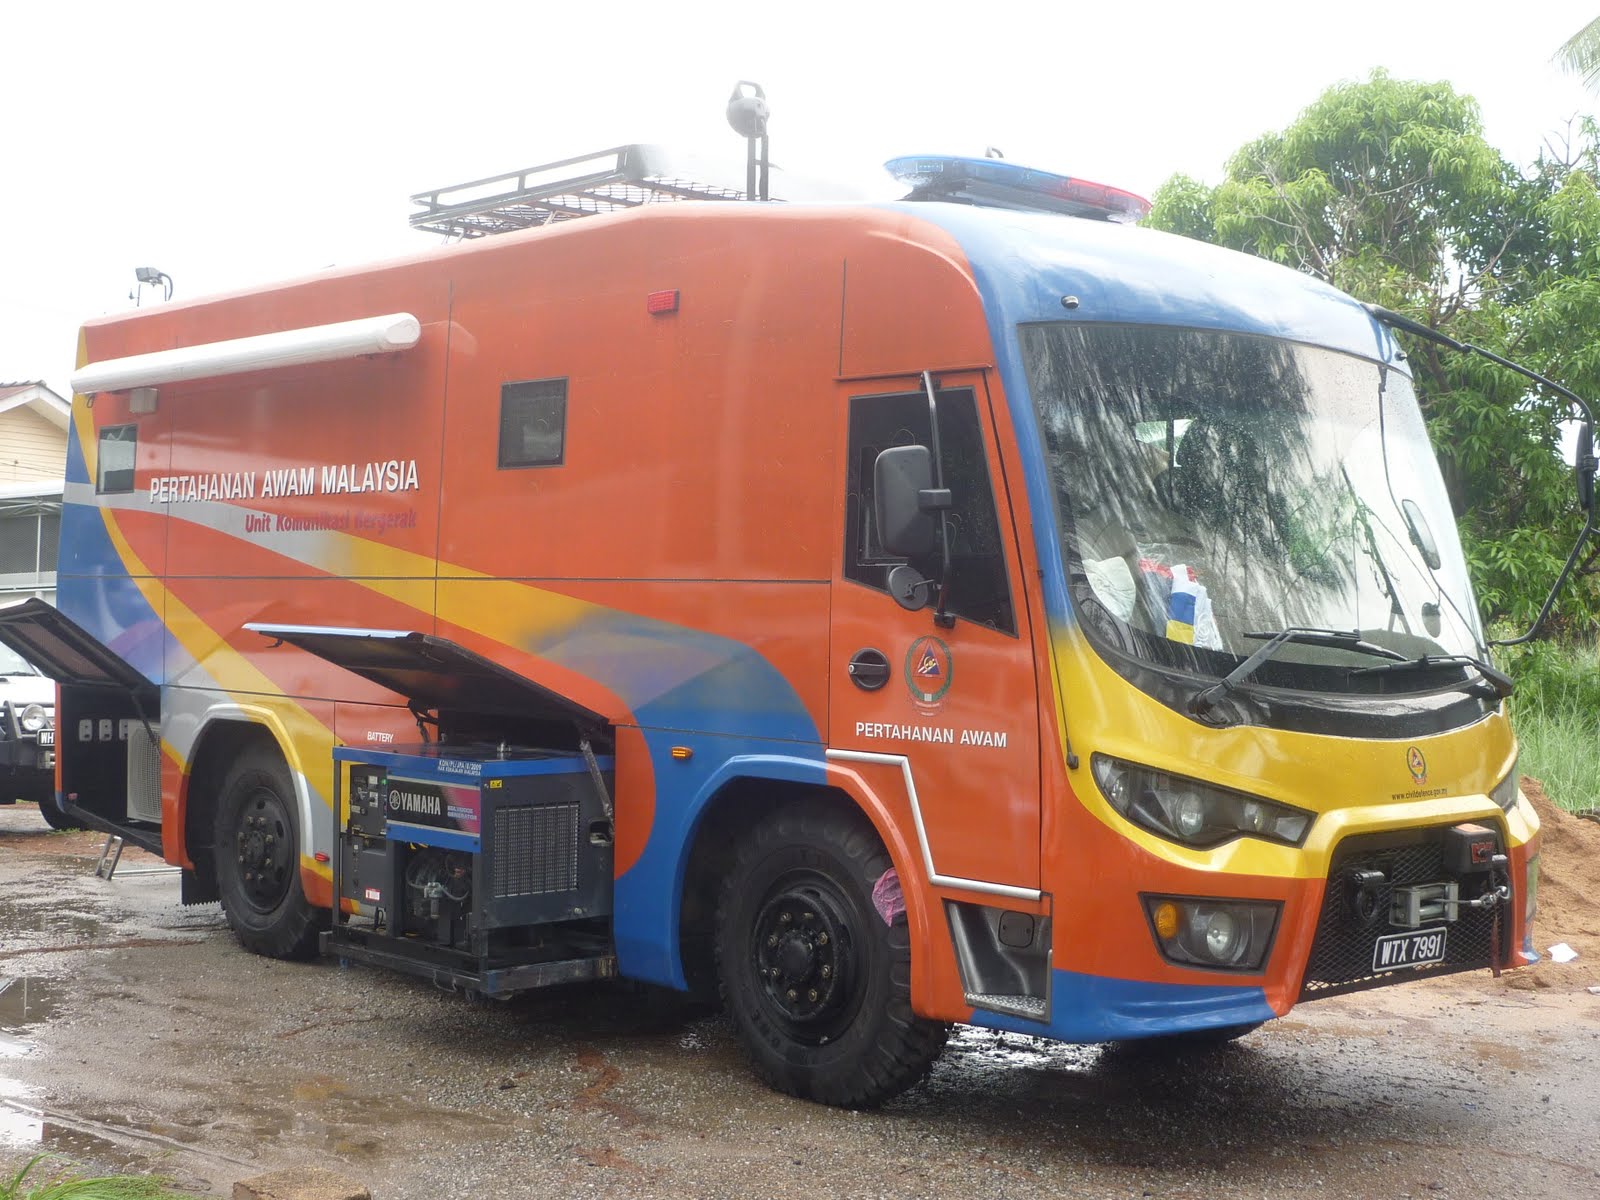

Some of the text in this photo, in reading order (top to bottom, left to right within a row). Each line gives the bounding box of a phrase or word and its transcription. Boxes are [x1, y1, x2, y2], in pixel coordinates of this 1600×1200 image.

[150, 460, 419, 503] PERTAHANAN AWAM MALAYSIA
[245, 513, 271, 532] Unit
[276, 510, 350, 532] Komunikasi
[367, 731, 394, 743] BATTERY
[855, 722, 1007, 748] PERTAHANAN AWAM
[401, 792, 441, 815] YAMAHA
[1381, 933, 1442, 965] WTX 7991
